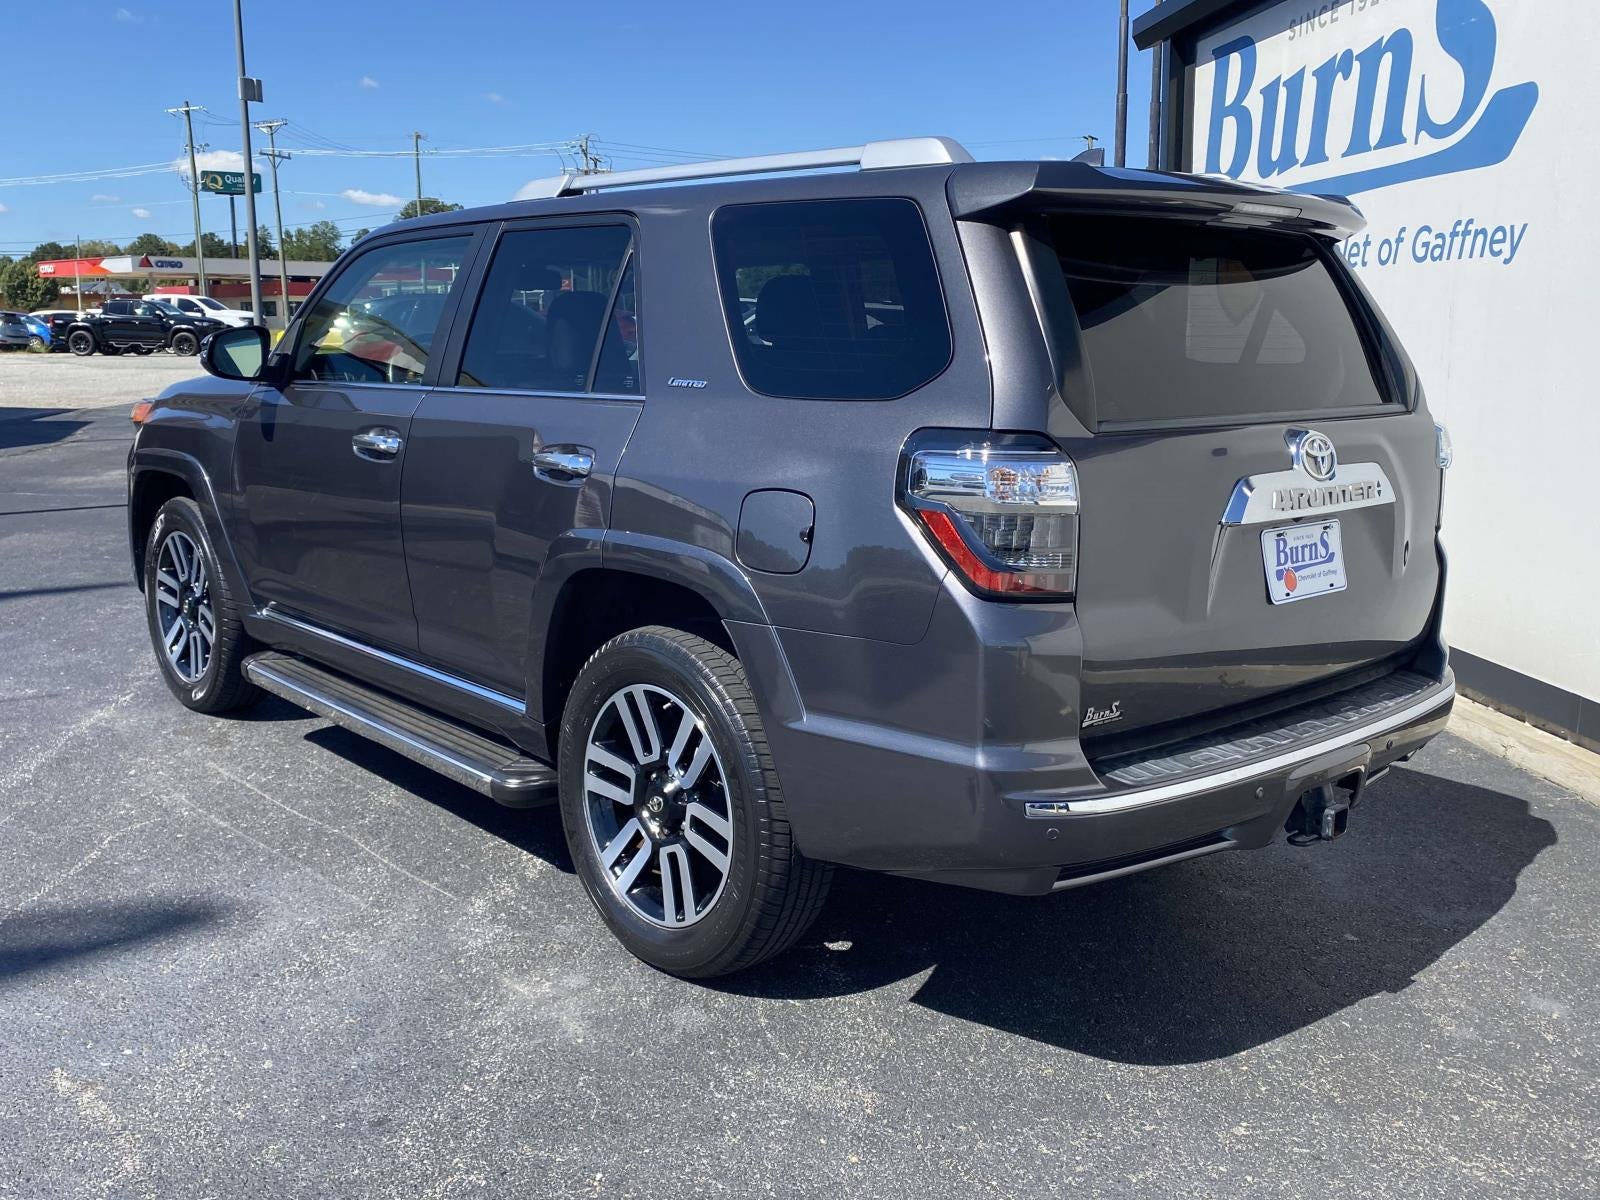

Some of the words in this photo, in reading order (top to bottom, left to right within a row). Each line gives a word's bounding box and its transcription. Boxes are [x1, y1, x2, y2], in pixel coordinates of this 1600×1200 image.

[1288, 0, 1340, 41] SINCE
[1377, 226, 1406, 267] of
[1412, 217, 1529, 265] Gaffney
